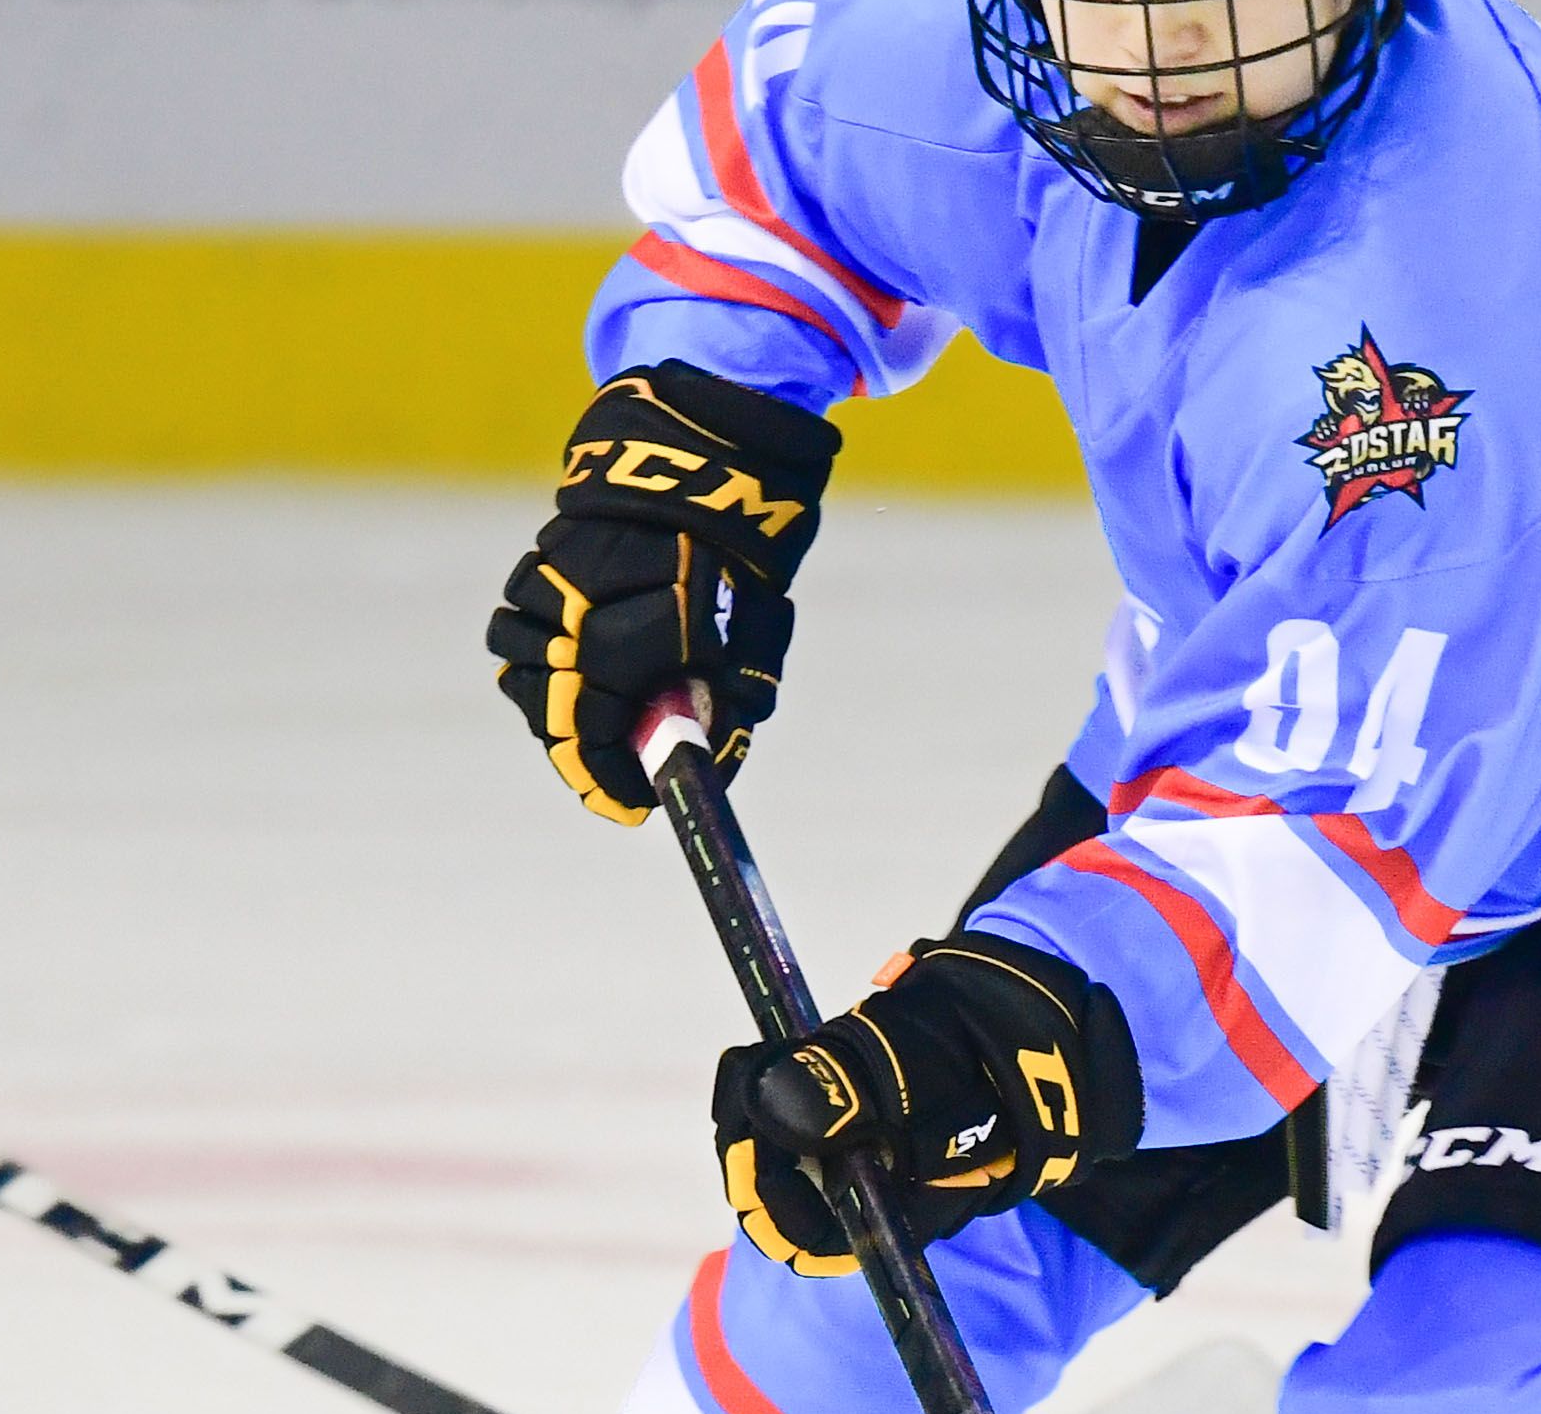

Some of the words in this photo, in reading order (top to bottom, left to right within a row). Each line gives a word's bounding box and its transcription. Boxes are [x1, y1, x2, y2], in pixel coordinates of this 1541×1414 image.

[560, 439, 807, 538] CCM
[1233, 618, 1449, 815] 94
[793, 1051, 846, 1108] CCM
